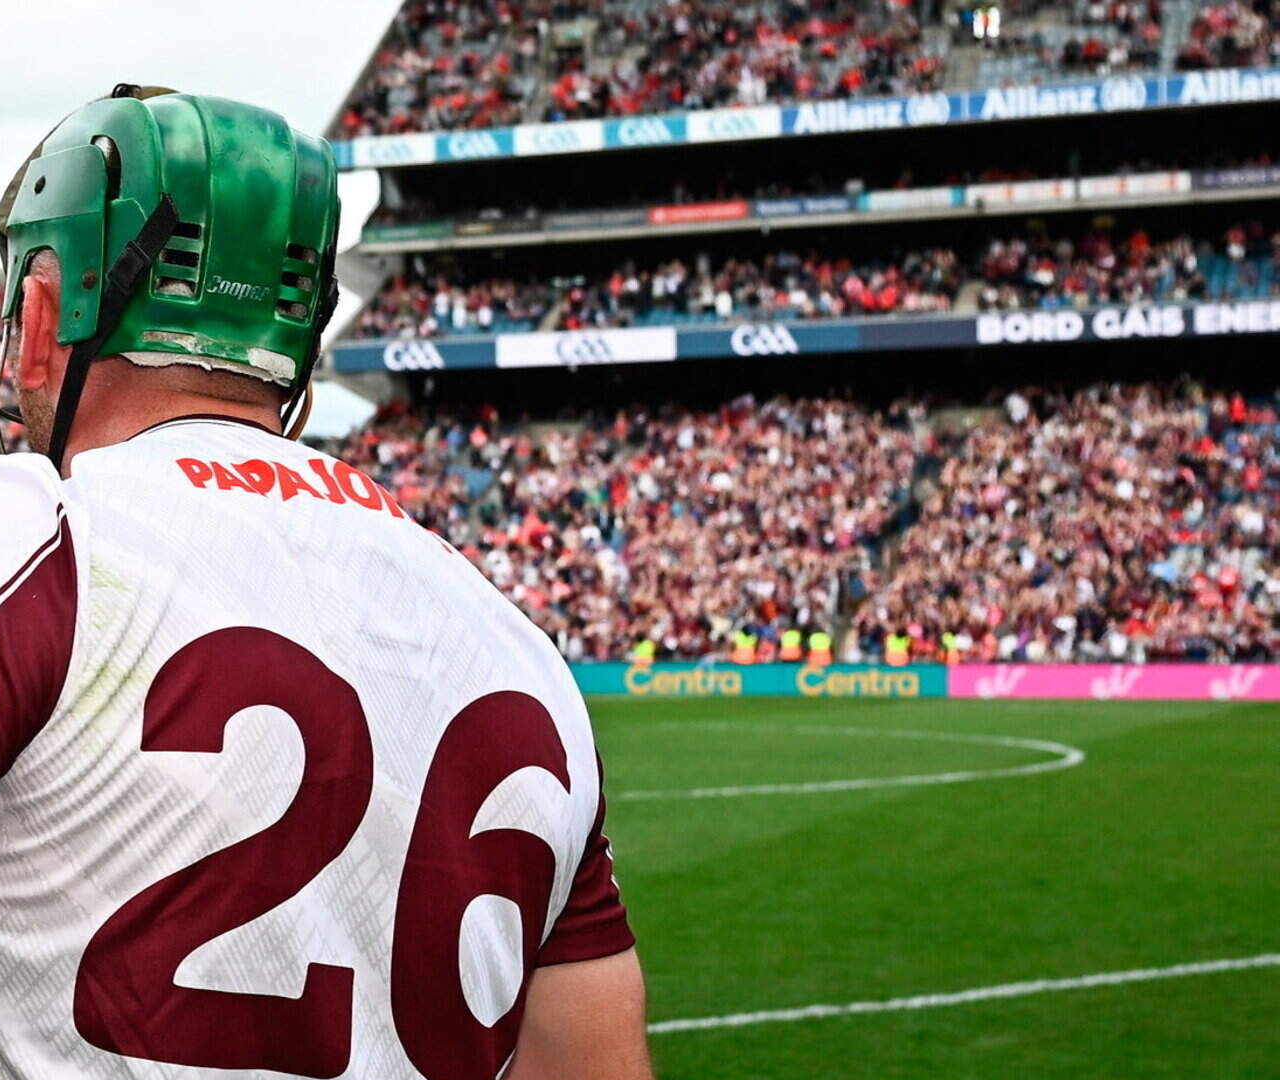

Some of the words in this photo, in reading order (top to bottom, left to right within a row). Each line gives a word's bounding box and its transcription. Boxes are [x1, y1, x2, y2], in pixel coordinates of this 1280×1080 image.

[792, 100, 904, 134] Allianz
[981, 85, 1098, 120] Allianz
[976, 312, 1084, 344] BORD
[624, 663, 742, 695] Centra
[796, 664, 920, 696] Centra
